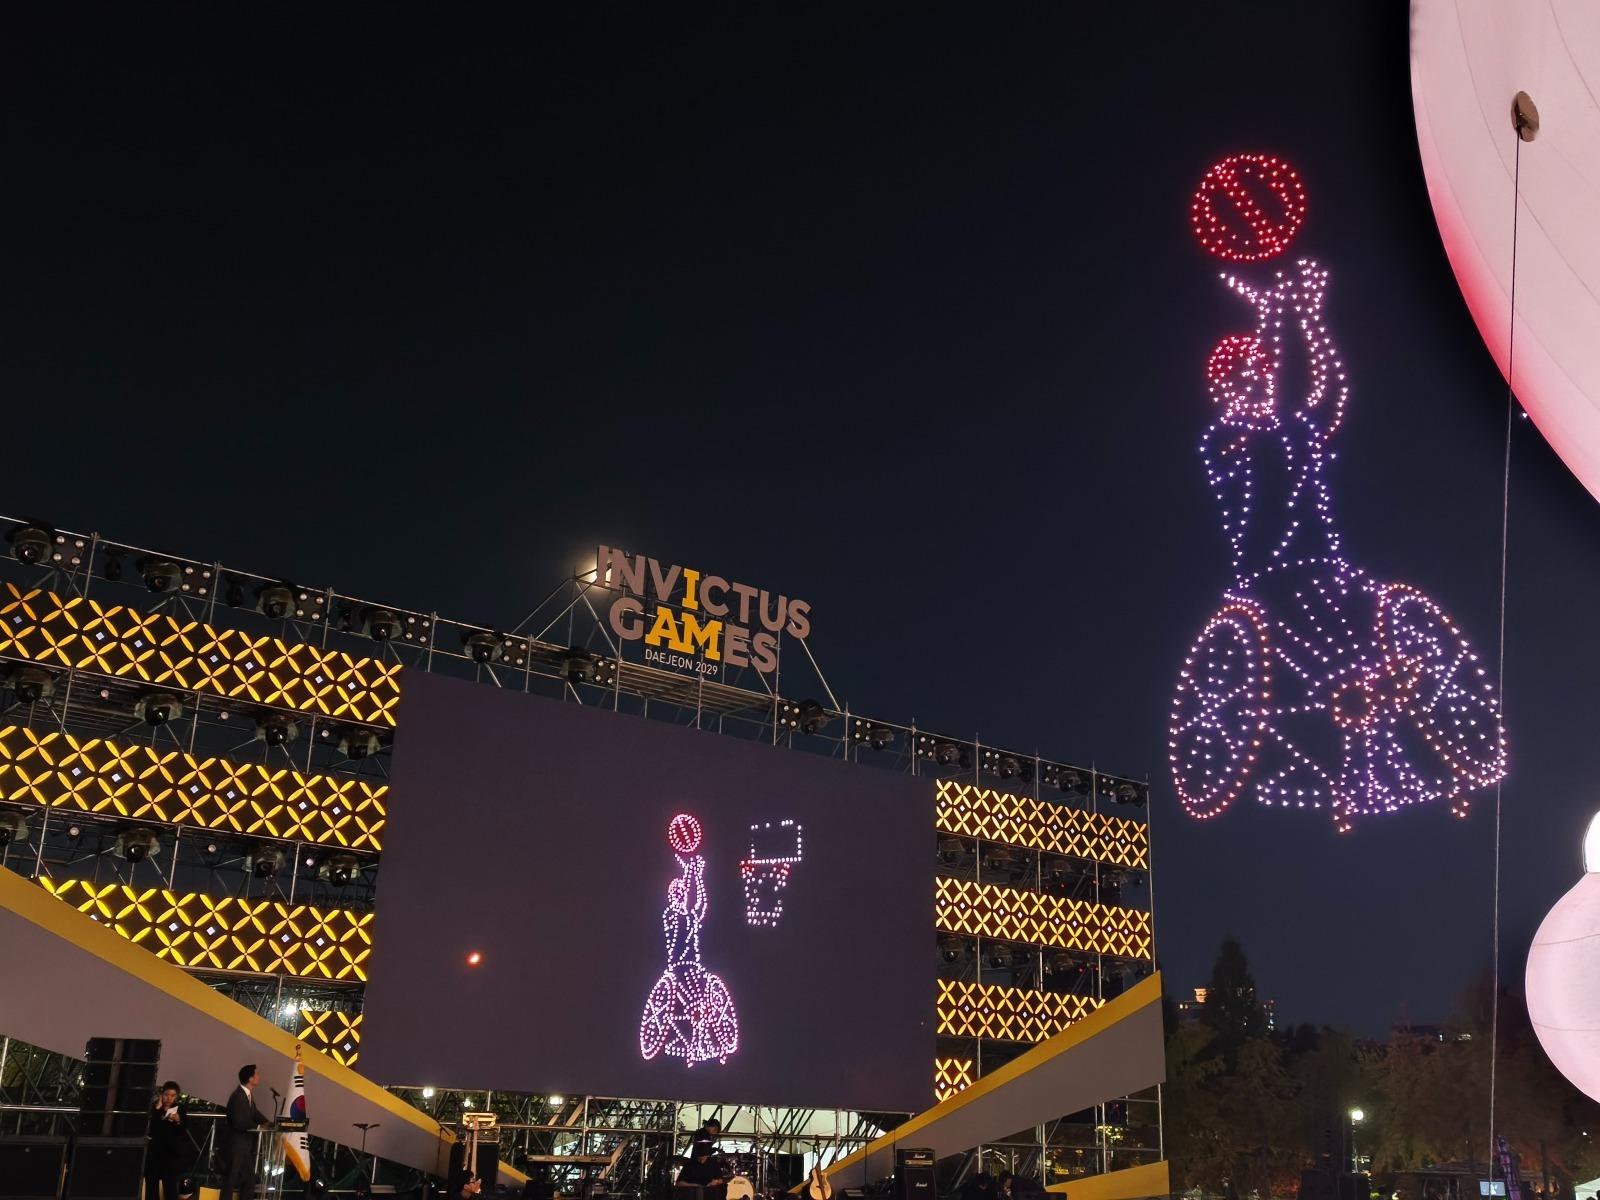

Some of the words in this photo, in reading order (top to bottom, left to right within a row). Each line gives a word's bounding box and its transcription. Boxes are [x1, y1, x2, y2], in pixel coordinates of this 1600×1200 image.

[596, 545, 812, 640] INVICTUS
[609, 597, 778, 673] GAMES
[645, 648, 693, 670] DAEJEON
[695, 661, 718, 676] 2029
